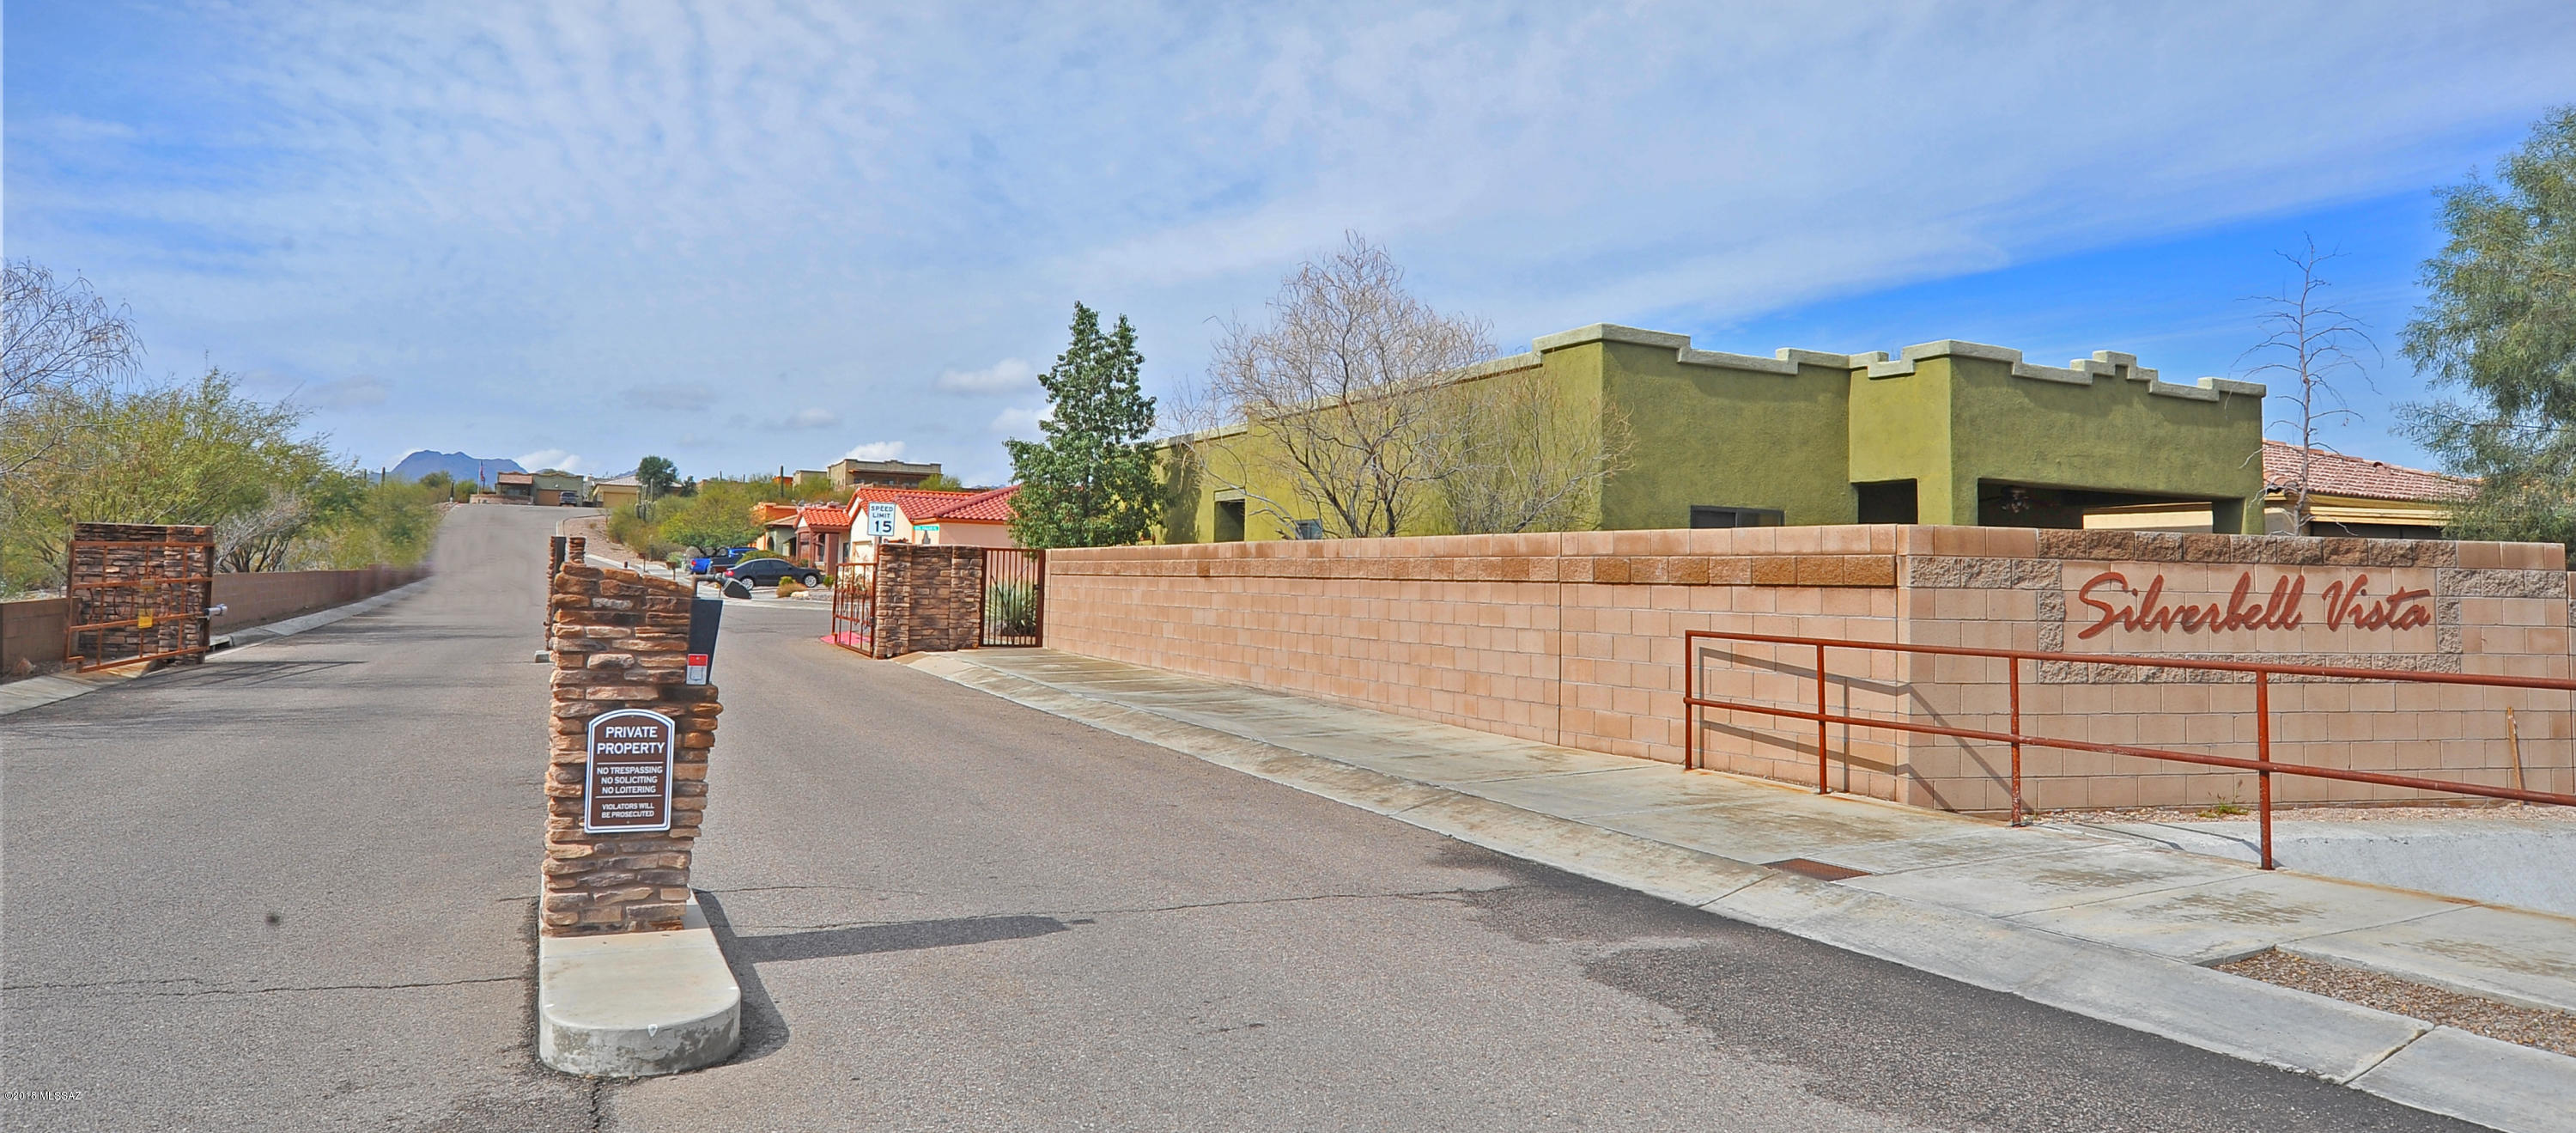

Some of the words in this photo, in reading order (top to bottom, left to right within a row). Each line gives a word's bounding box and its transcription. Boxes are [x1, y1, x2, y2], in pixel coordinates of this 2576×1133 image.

[875, 520, 892, 533] 15
[2077, 571, 2306, 640] Silverbell
[2322, 573, 2431, 631] Vista
[605, 726, 658, 738] PRIVATE
[597, 741, 665, 754] PROPERTY
[615, 785, 656, 794] LOITERING
